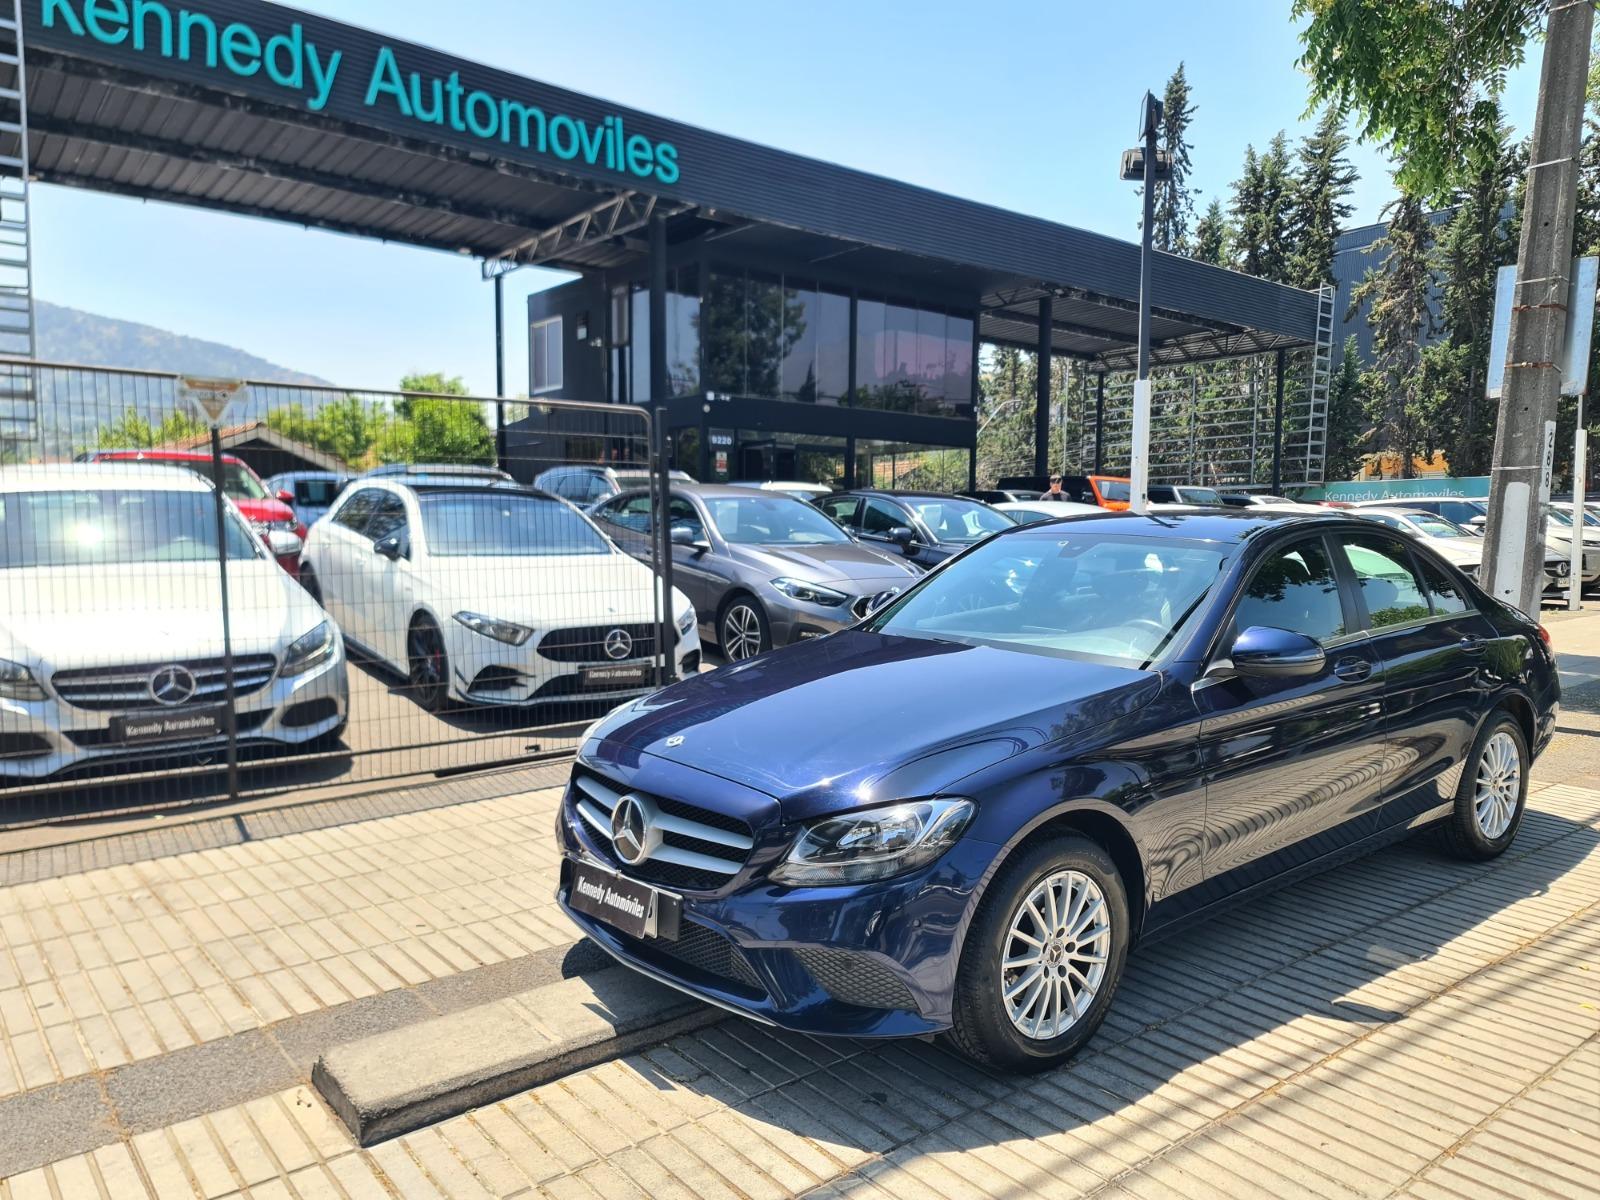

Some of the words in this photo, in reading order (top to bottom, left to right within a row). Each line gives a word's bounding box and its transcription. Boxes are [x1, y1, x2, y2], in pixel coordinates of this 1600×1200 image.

[364, 46, 680, 184] Automoviles
[1324, 490, 1378, 502] Kennedy
[577, 876, 605, 904] Kennedy
[604, 887, 645, 918] Automóviles
